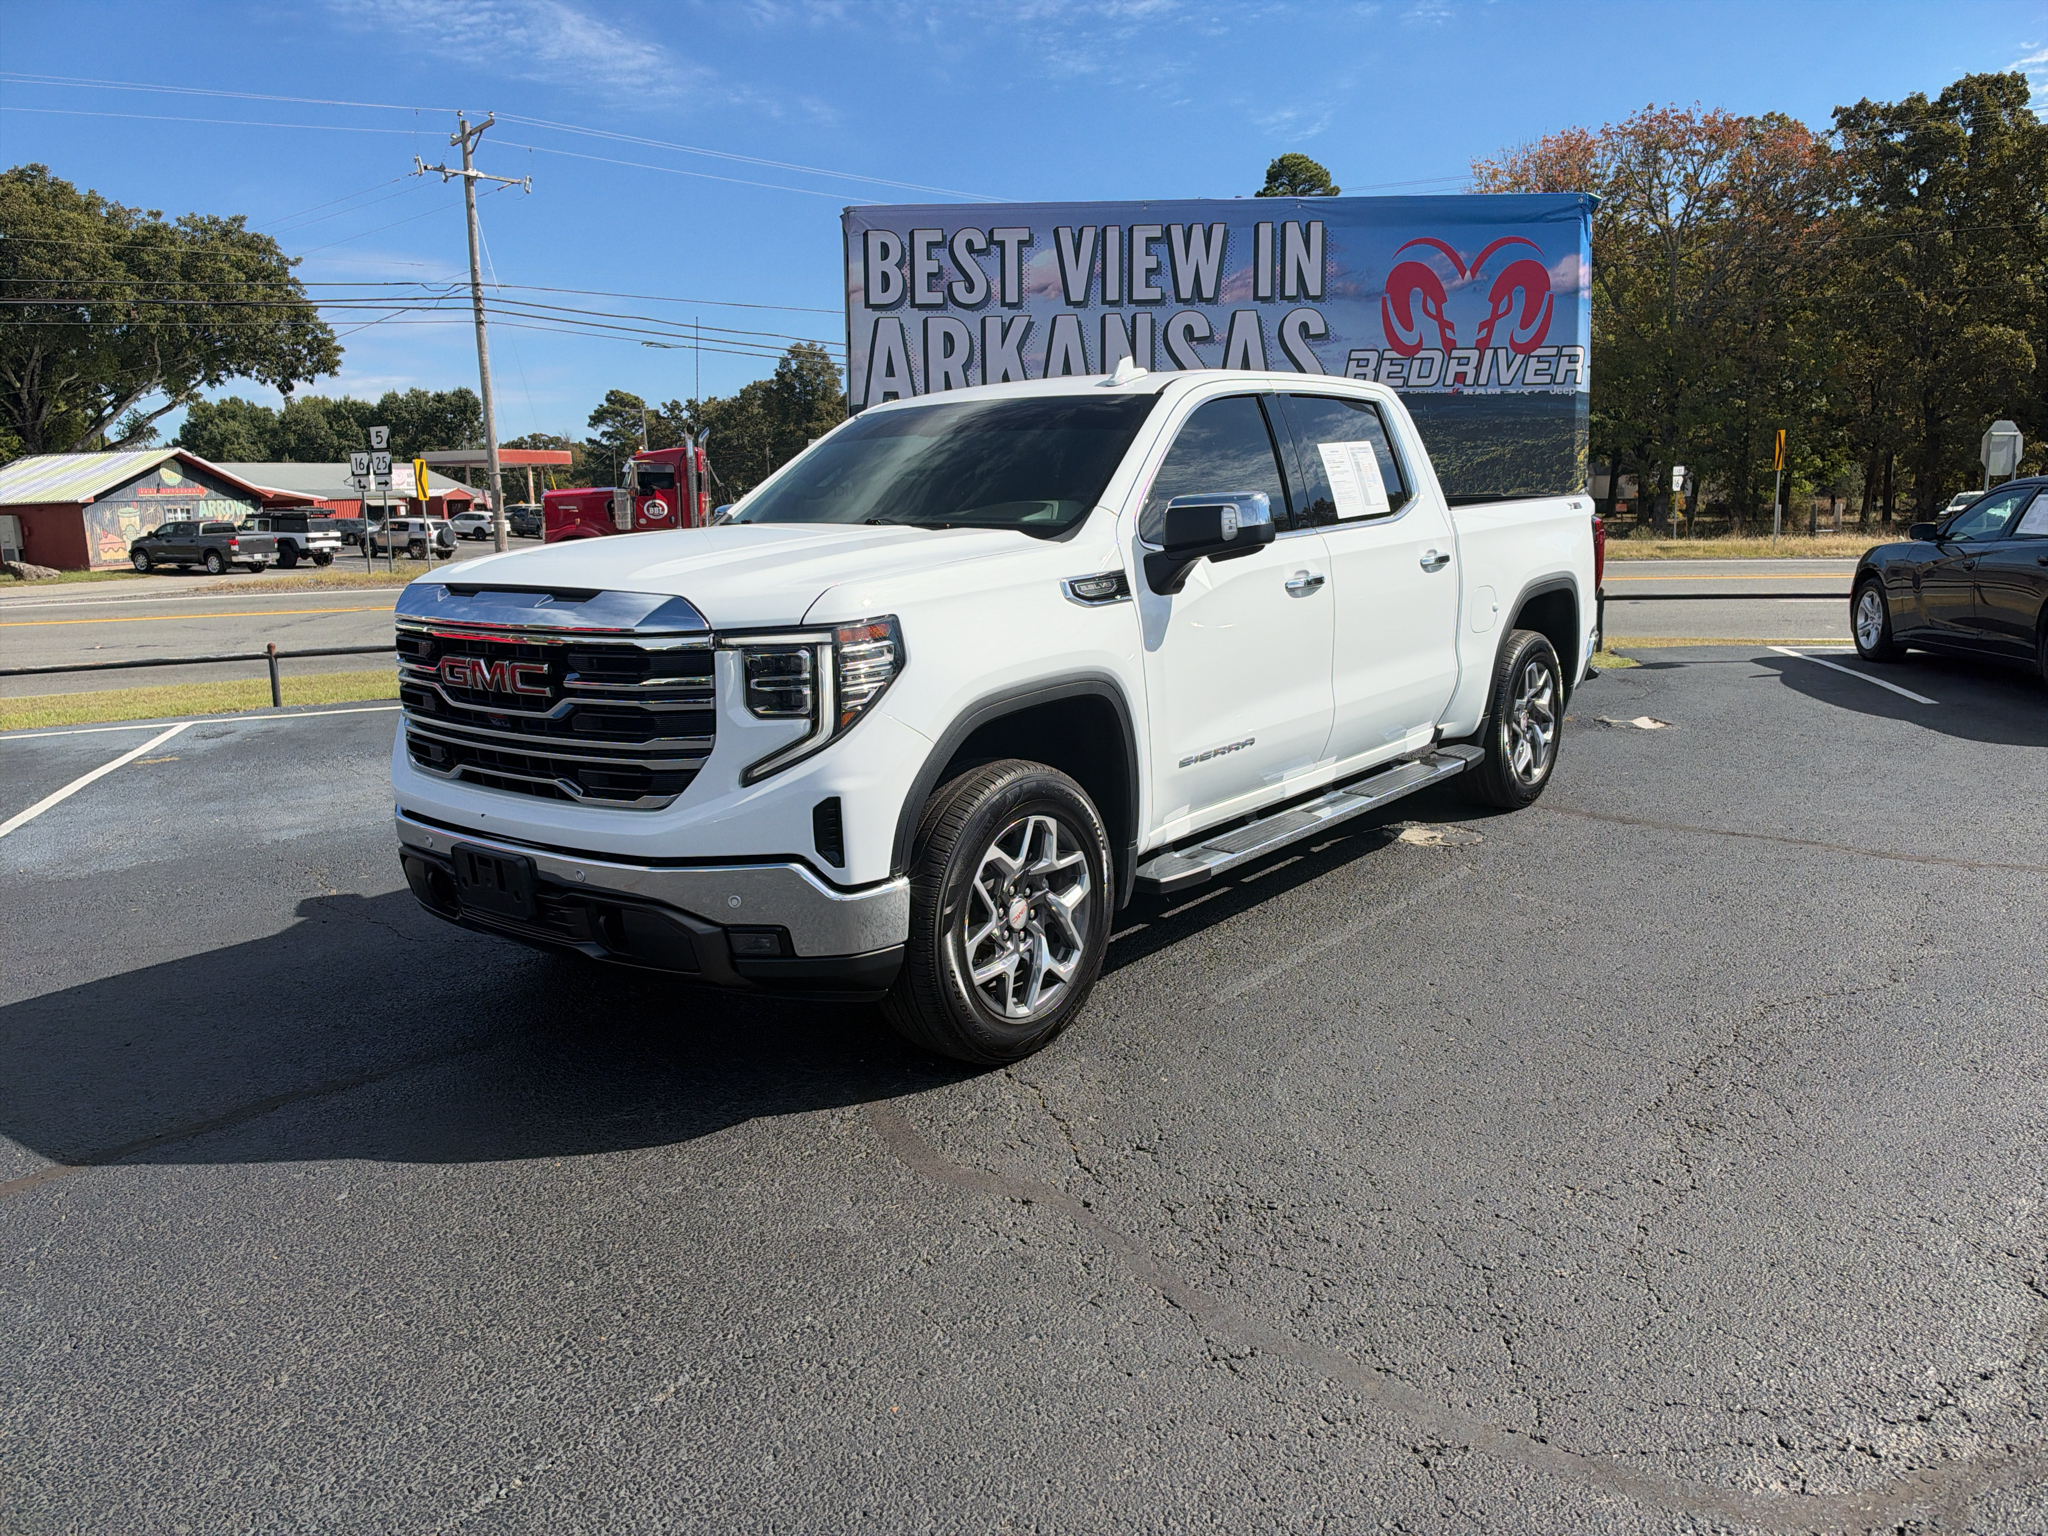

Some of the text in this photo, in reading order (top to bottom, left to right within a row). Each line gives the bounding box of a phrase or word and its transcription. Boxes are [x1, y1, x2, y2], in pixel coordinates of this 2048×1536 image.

[863, 220, 1326, 310] BEST VIEW IN
[861, 307, 1329, 408] ARKANSAS
[1463, 388, 1501, 396] RAM
[1549, 385, 1577, 397] Jeep
[375, 430, 384, 445] 5
[354, 457, 365, 471] 16
[375, 456, 388, 471] 25
[439, 655, 553, 698] GMC
[1178, 737, 1256, 769] SIERRA
